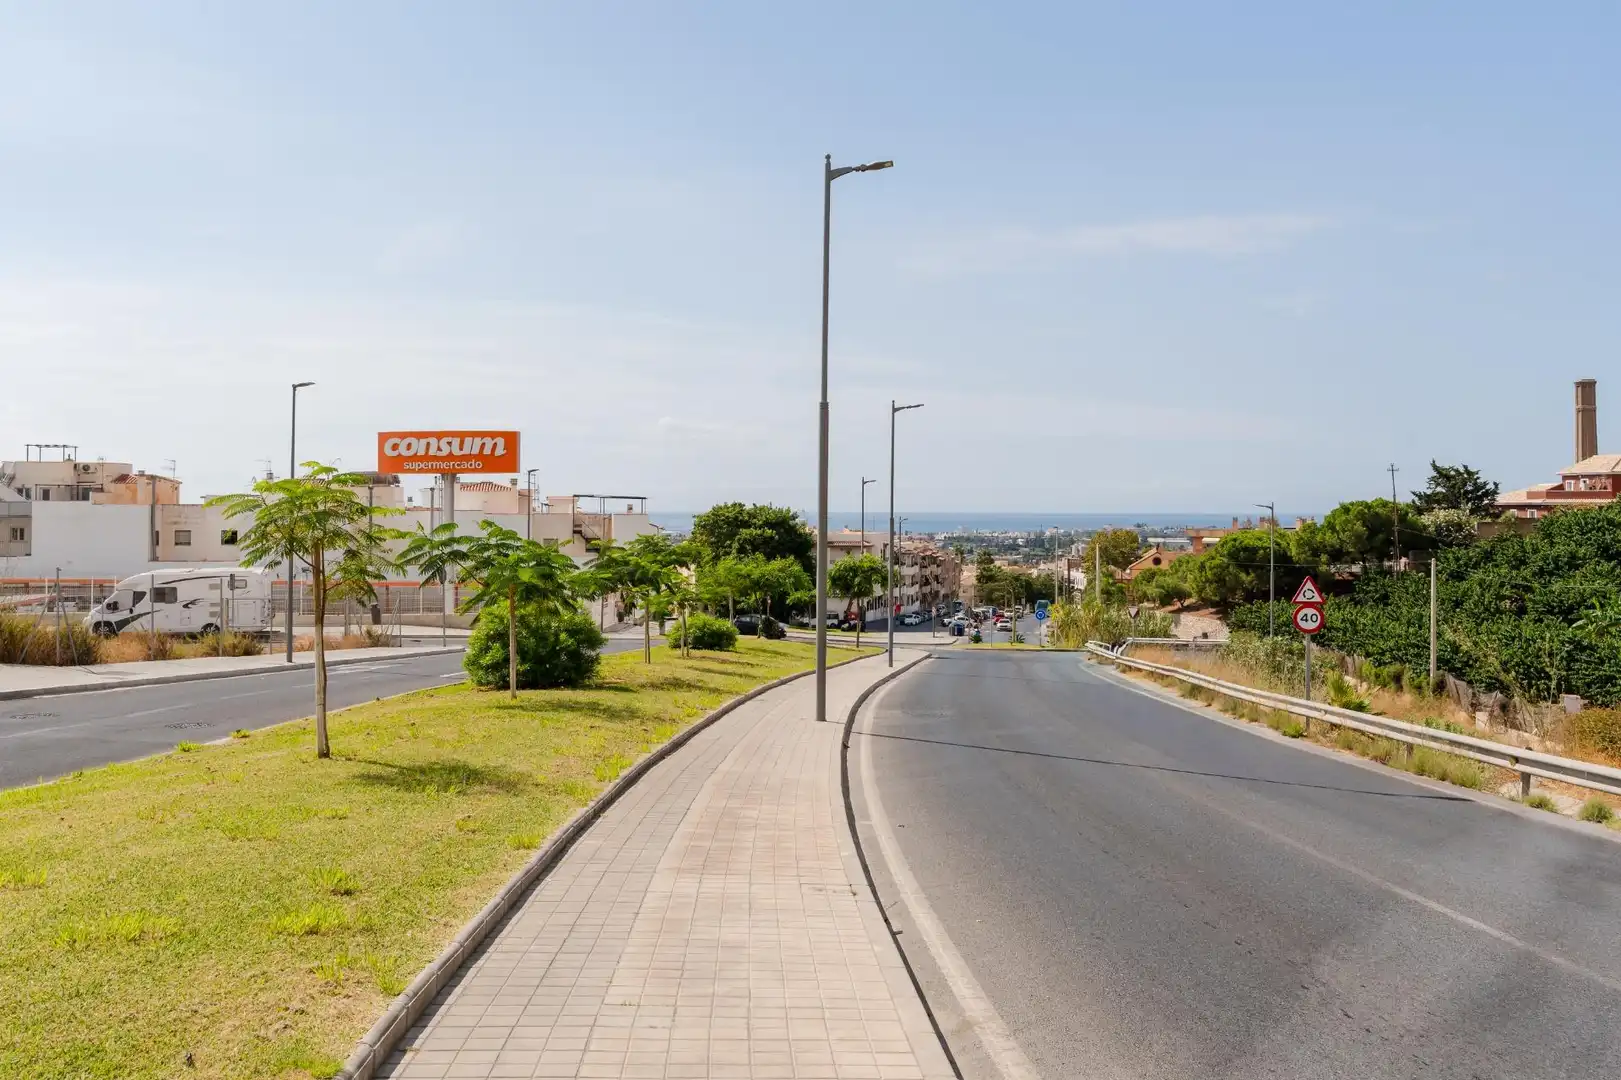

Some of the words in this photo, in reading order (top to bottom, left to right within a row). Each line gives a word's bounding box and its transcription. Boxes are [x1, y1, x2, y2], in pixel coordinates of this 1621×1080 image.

[384, 437, 507, 457] consum
[403, 459, 483, 470] supermercado
[1300, 613, 1319, 623] 40
